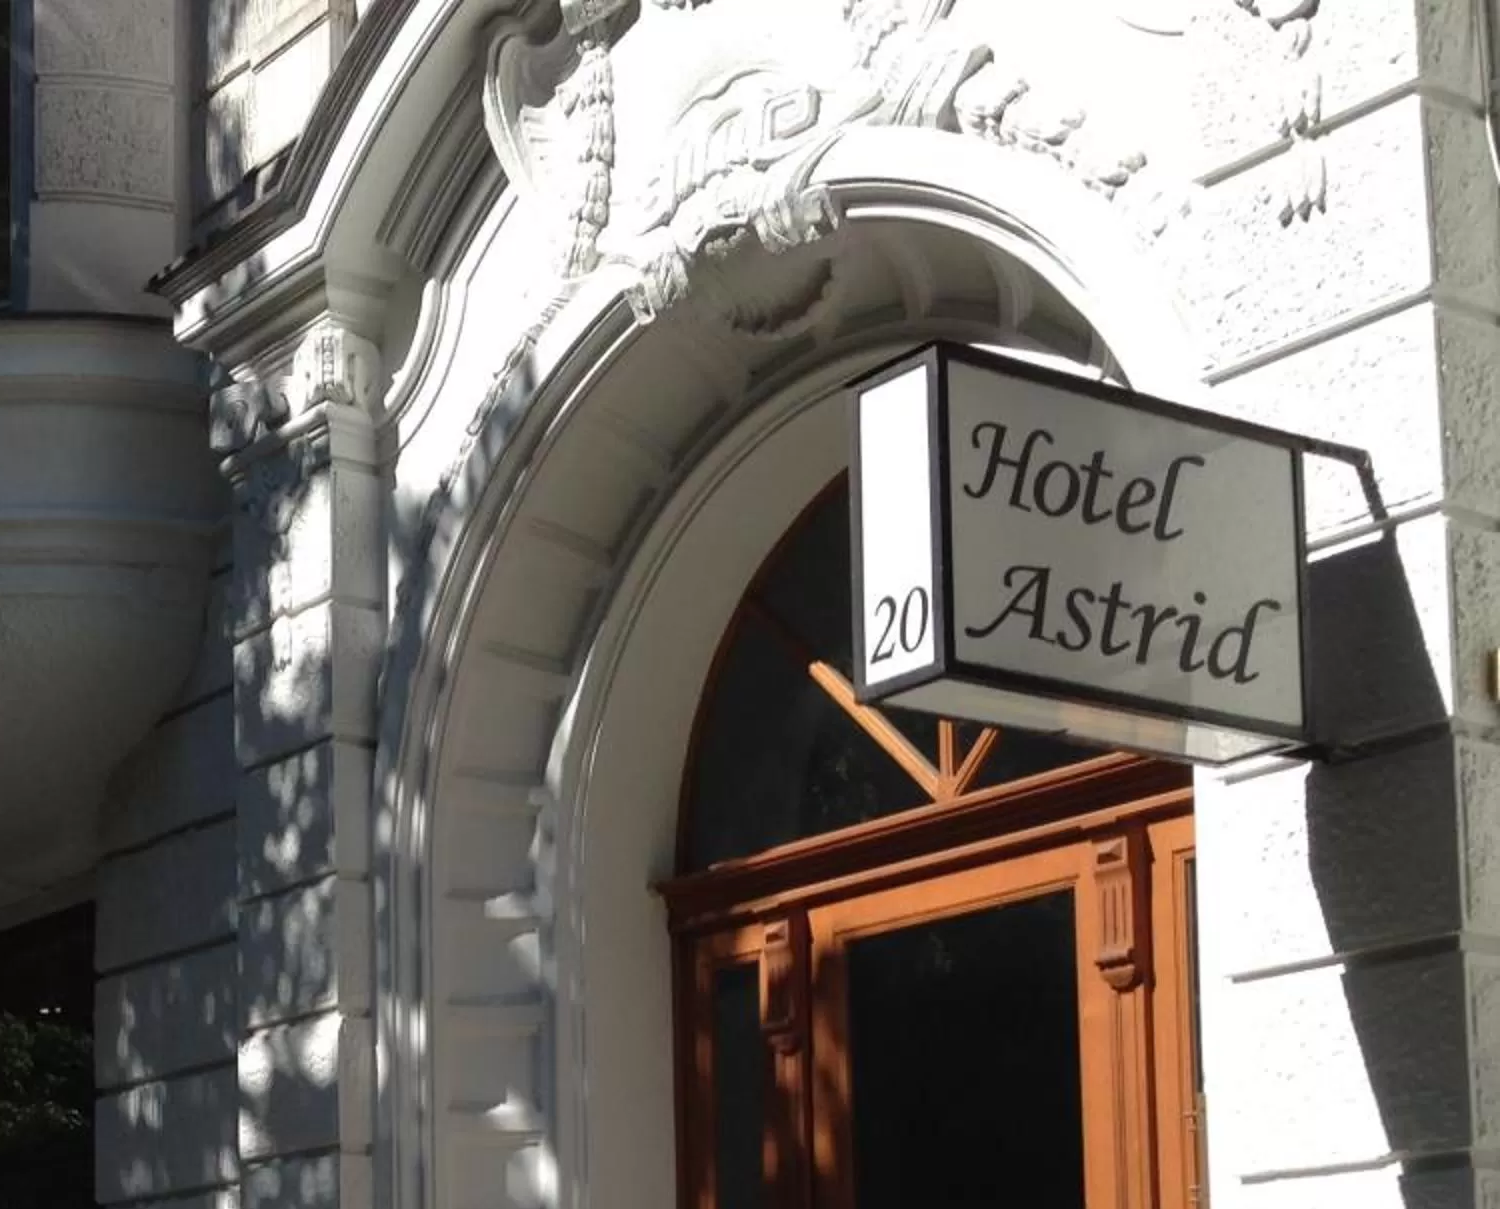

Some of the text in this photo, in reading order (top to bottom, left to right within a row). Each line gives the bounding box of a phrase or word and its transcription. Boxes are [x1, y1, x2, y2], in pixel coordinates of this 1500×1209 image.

[963, 421, 1204, 542] Hotel
[869, 586, 928, 665] 20
[964, 565, 1281, 685] Astrid
